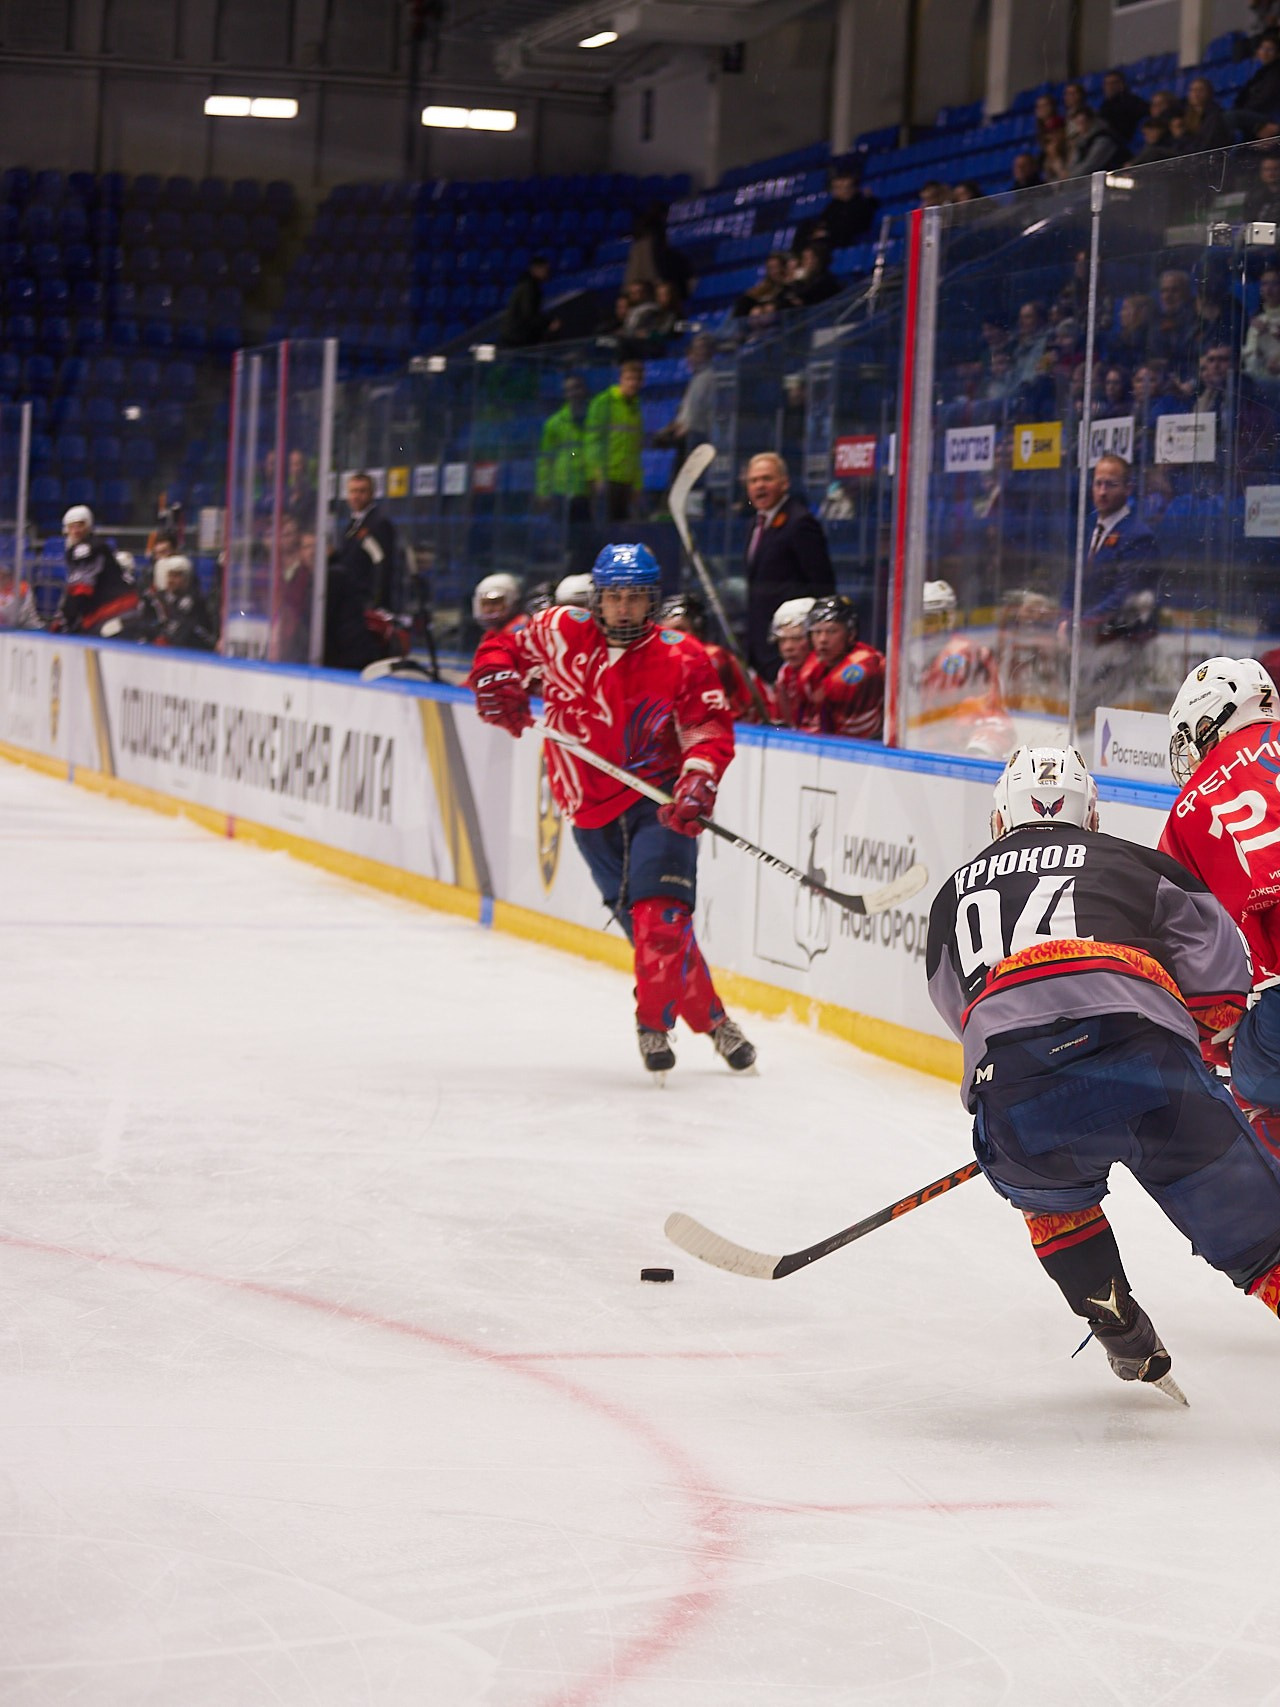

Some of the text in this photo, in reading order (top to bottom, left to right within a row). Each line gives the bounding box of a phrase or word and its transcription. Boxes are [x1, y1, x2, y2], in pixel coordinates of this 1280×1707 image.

[220, 692, 332, 807] ХОККЕЙНАЯ
[337, 730, 396, 825] ЛИГА
[1111, 741, 1166, 769] Ростелеком
[843, 834, 915, 882] НИЖНИЙ
[954, 844, 1087, 900] КРЮКОВ
